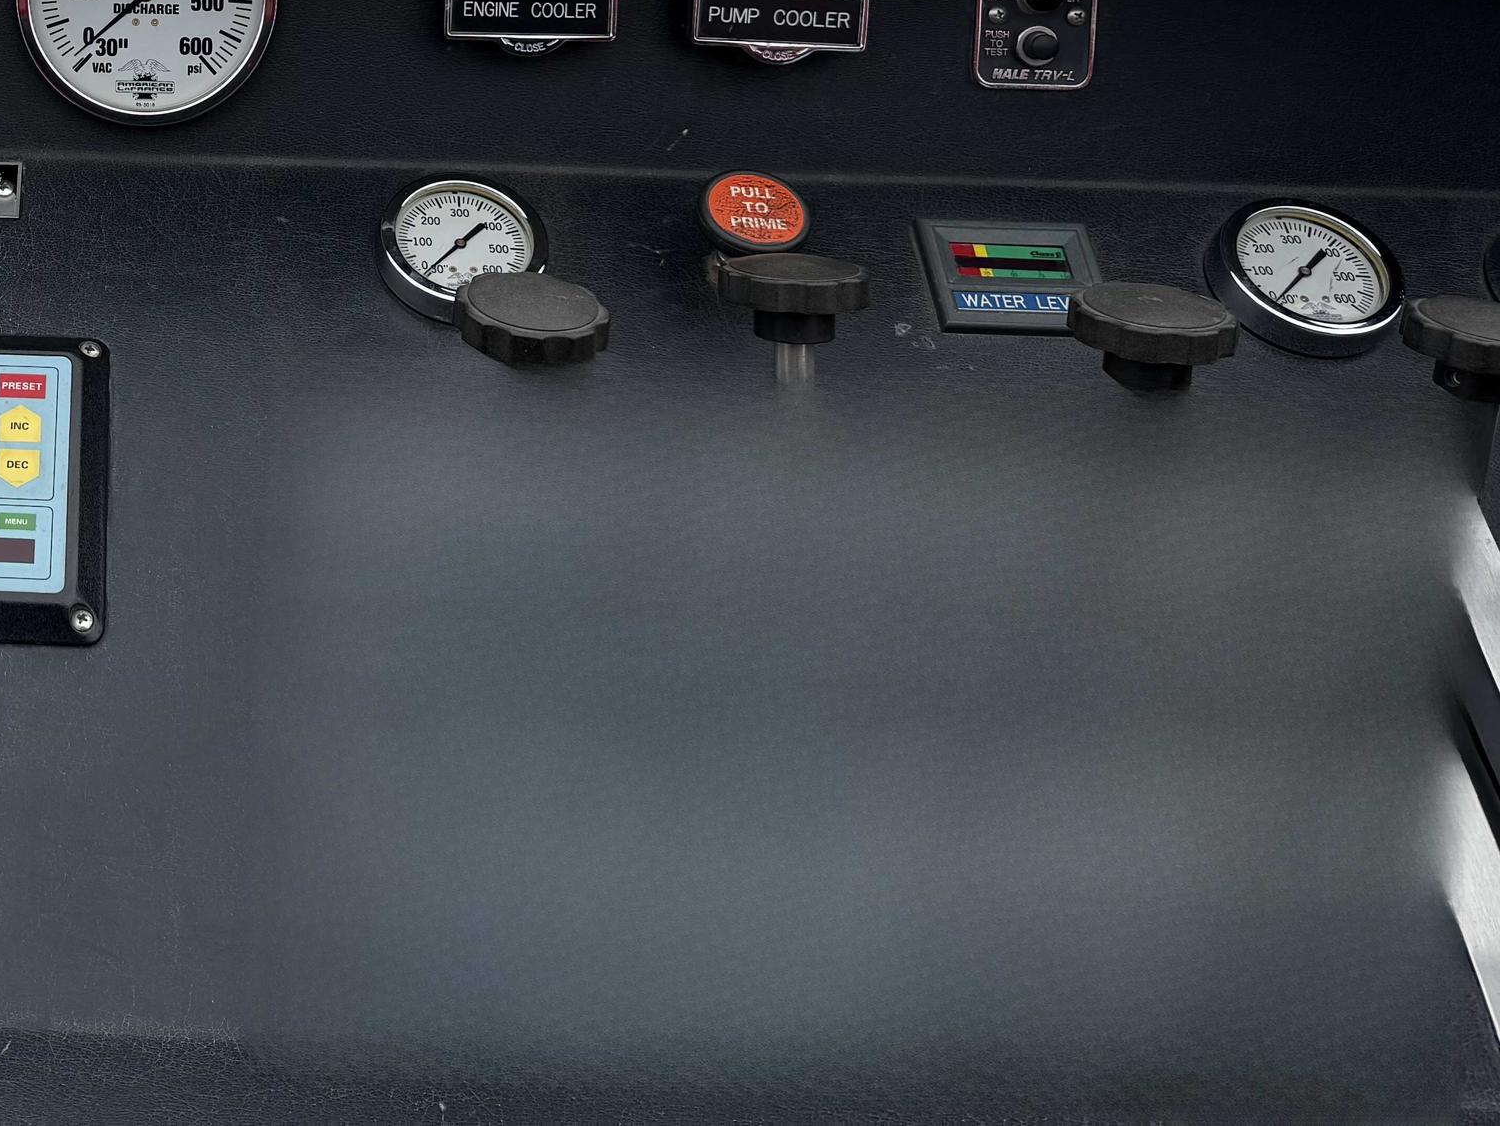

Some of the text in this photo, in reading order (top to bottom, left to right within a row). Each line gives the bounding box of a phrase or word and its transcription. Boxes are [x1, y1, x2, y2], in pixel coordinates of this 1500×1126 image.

[113, 3, 180, 15] DISCHARGE
[463, 1, 597, 19] ENGINE COOLER
[708, 6, 850, 29] PUMP COOLER
[83, 27, 95, 45] 0
[985, 30, 1010, 38] PUSH
[95, 38, 129, 57] 30"
[179, 37, 213, 56] 600
[514, 42, 546, 52] CLOSE
[990, 39, 1003, 47] TO
[762, 50, 795, 61] CLOSE
[984, 48, 1008, 56] TEST
[92, 62, 112, 74] VAC
[187, 63, 202, 75] psi
[992, 68, 1075, 81] HALE TRV-L
[730, 186, 776, 199] PULL
[742, 201, 769, 213] TO
[450, 208, 469, 217] 300
[420, 216, 441, 226] 200
[730, 215, 788, 230] PRIME
[413, 237, 433, 246] 100
[1280, 235, 1302, 244] 300
[489, 245, 509, 254] 500
[1252, 243, 1274, 253] 200
[482, 265, 503, 273] 600
[1251, 265, 1274, 275] 100
[1333, 272, 1355, 282] 500
[961, 293, 1070, 311] WATER LEV
[1334, 294, 1356, 304] 600
[2, 381, 42, 391] PRESET
[10, 422, 29, 431] INC
[7, 460, 29, 469] DEC
